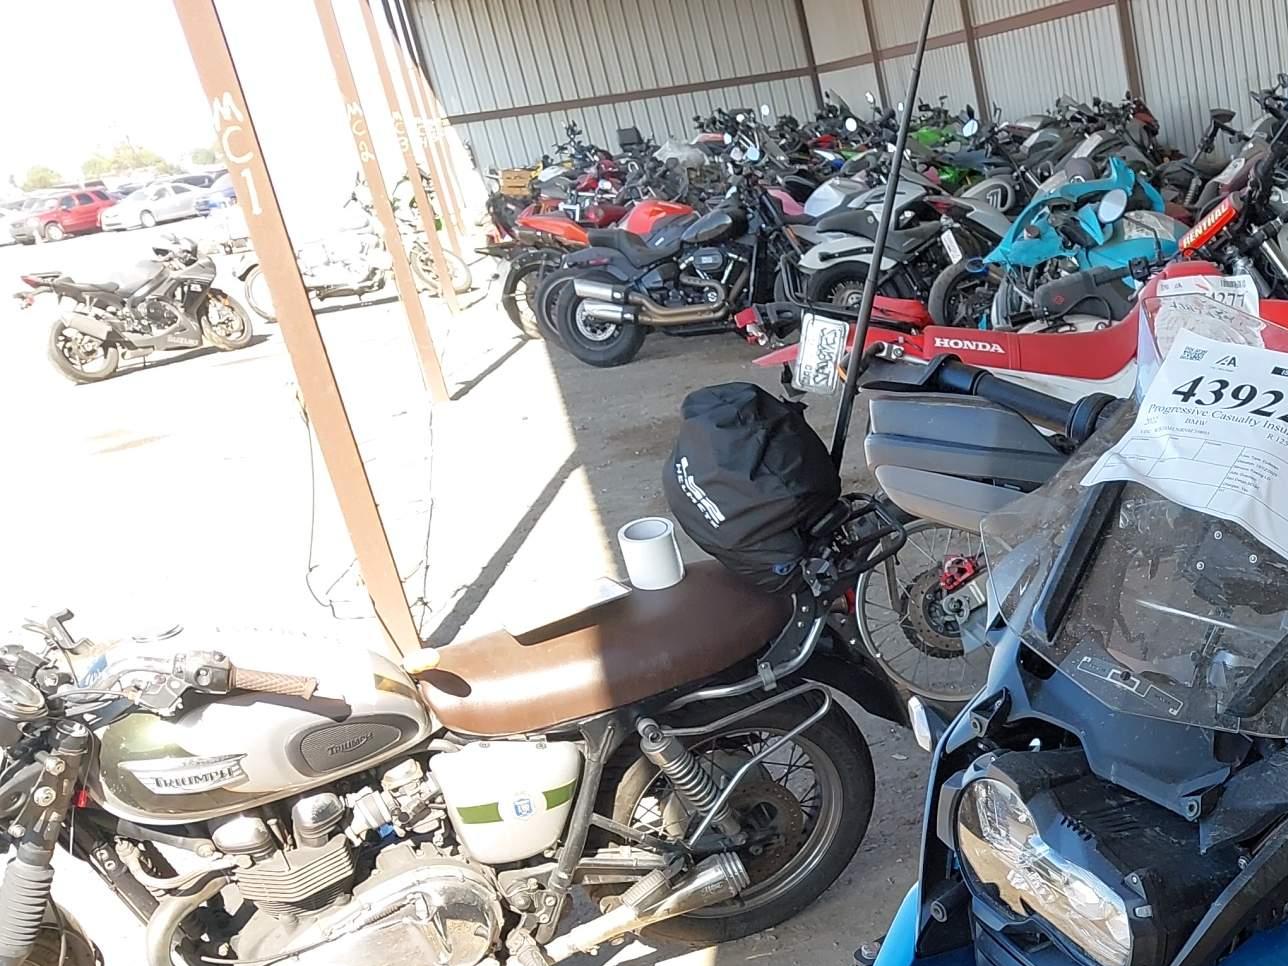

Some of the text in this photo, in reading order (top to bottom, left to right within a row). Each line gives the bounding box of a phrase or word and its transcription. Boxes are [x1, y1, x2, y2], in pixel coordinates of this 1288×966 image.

[1182, 201, 1229, 249] RENTHAL
[934, 337, 1006, 354] HONDA
[1149, 404, 1209, 418] Progressive
[1211, 410, 1262, 428] Casualty
[1184, 417, 1208, 427] BMW
[1266, 433, 1274, 441] R
[675, 463, 720, 529] HELMETS
[326, 731, 374, 756] TRIUMPH
[154, 767, 236, 788] TRIUMPH
